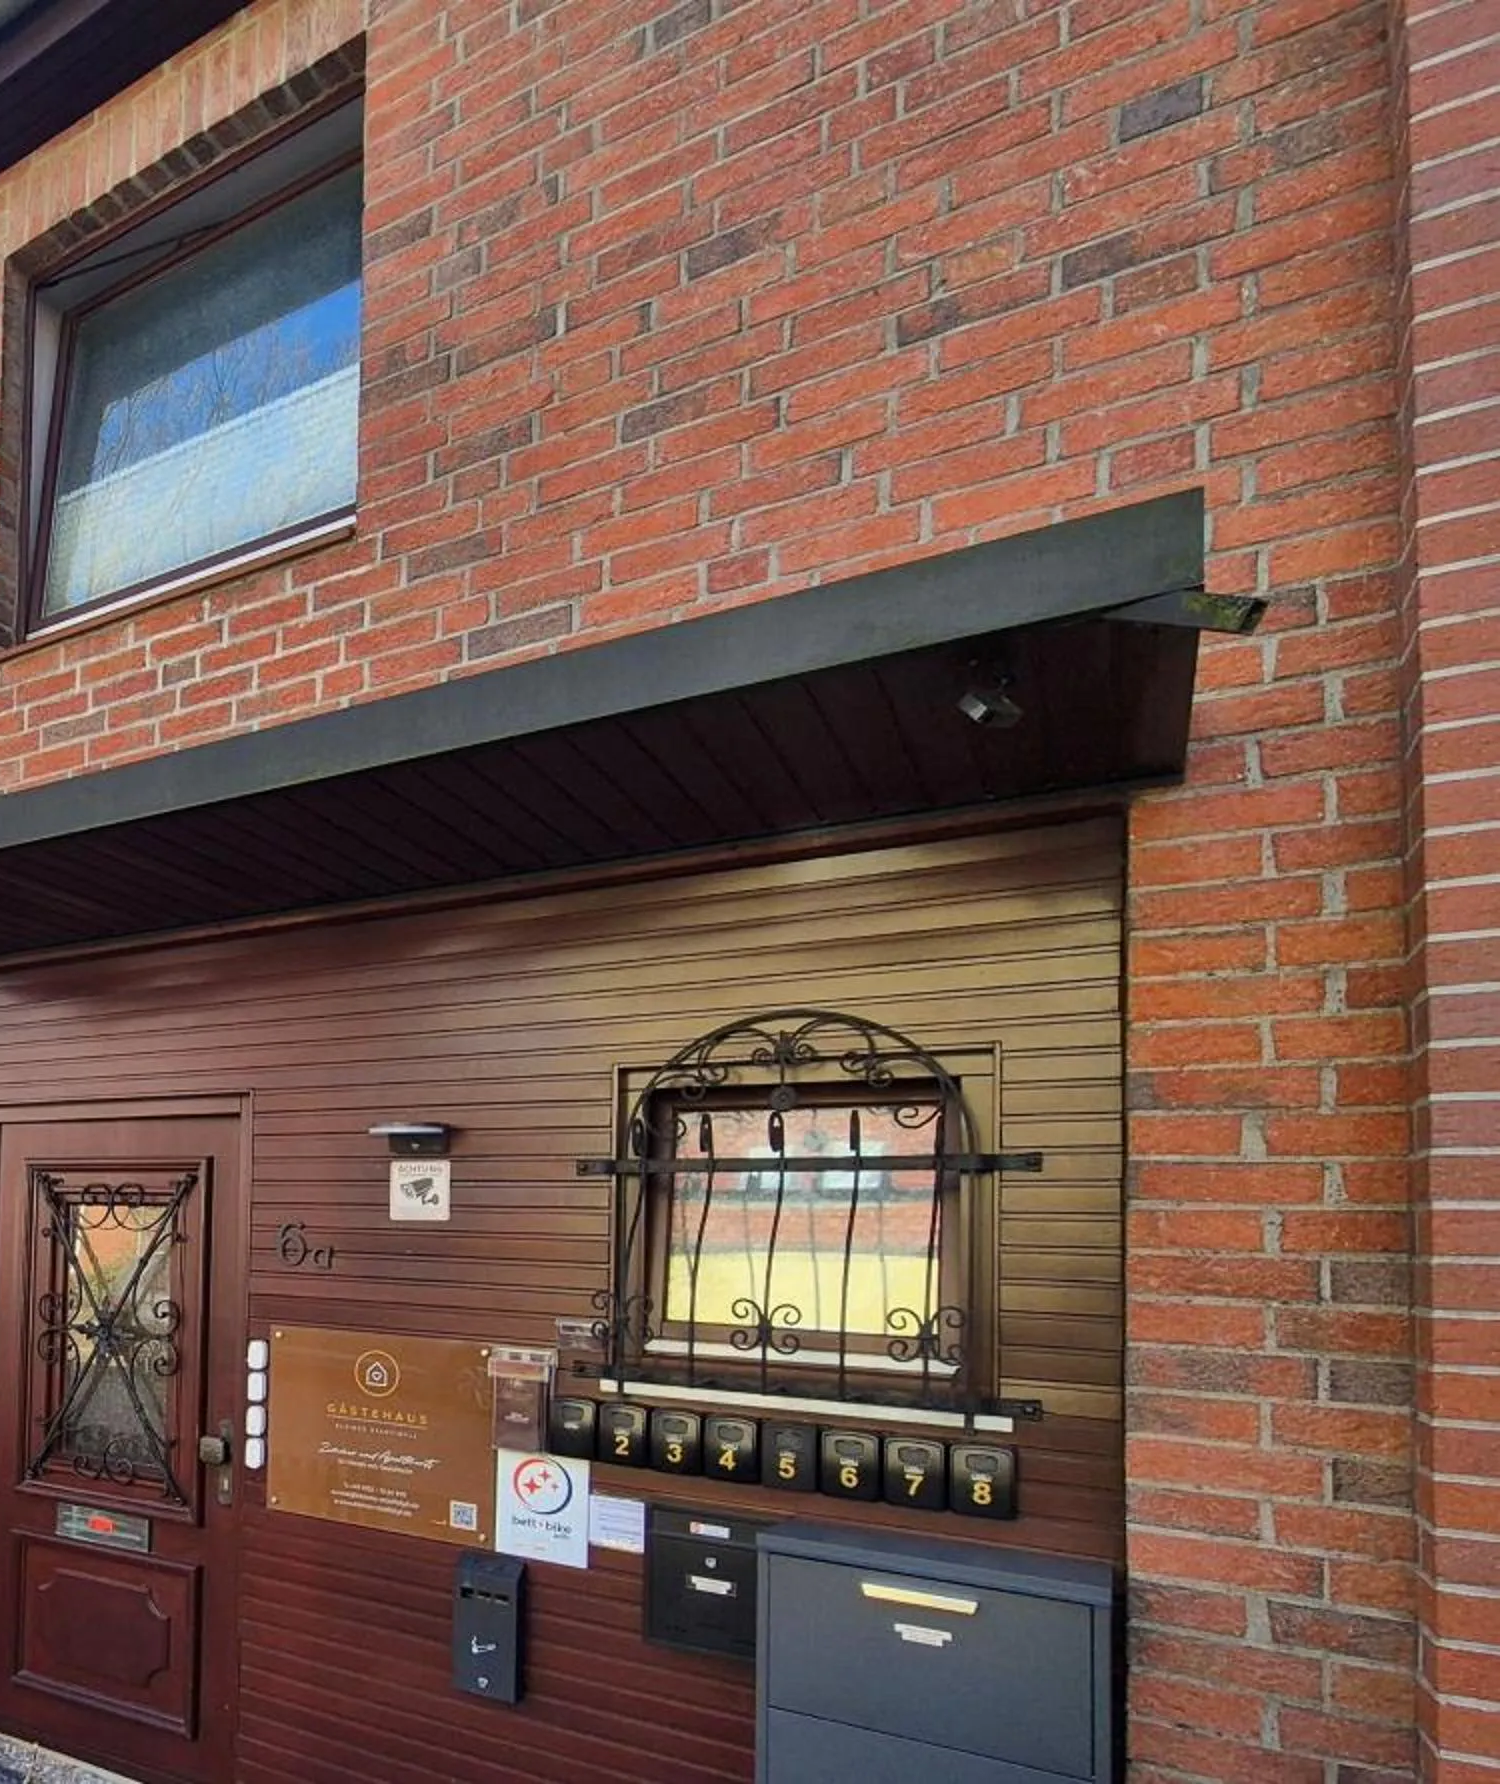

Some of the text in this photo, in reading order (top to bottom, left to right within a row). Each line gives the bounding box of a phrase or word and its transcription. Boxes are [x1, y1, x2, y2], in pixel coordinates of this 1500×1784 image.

[277, 1222, 334, 1269] 6a
[614, 1435, 629, 1455] 2
[666, 1443, 682, 1463] 3
[718, 1448, 736, 1471] 4
[778, 1458, 796, 1479] 5
[840, 1467, 859, 1488] 6
[904, 1474, 924, 1496] 7
[972, 1481, 992, 1505] 8
